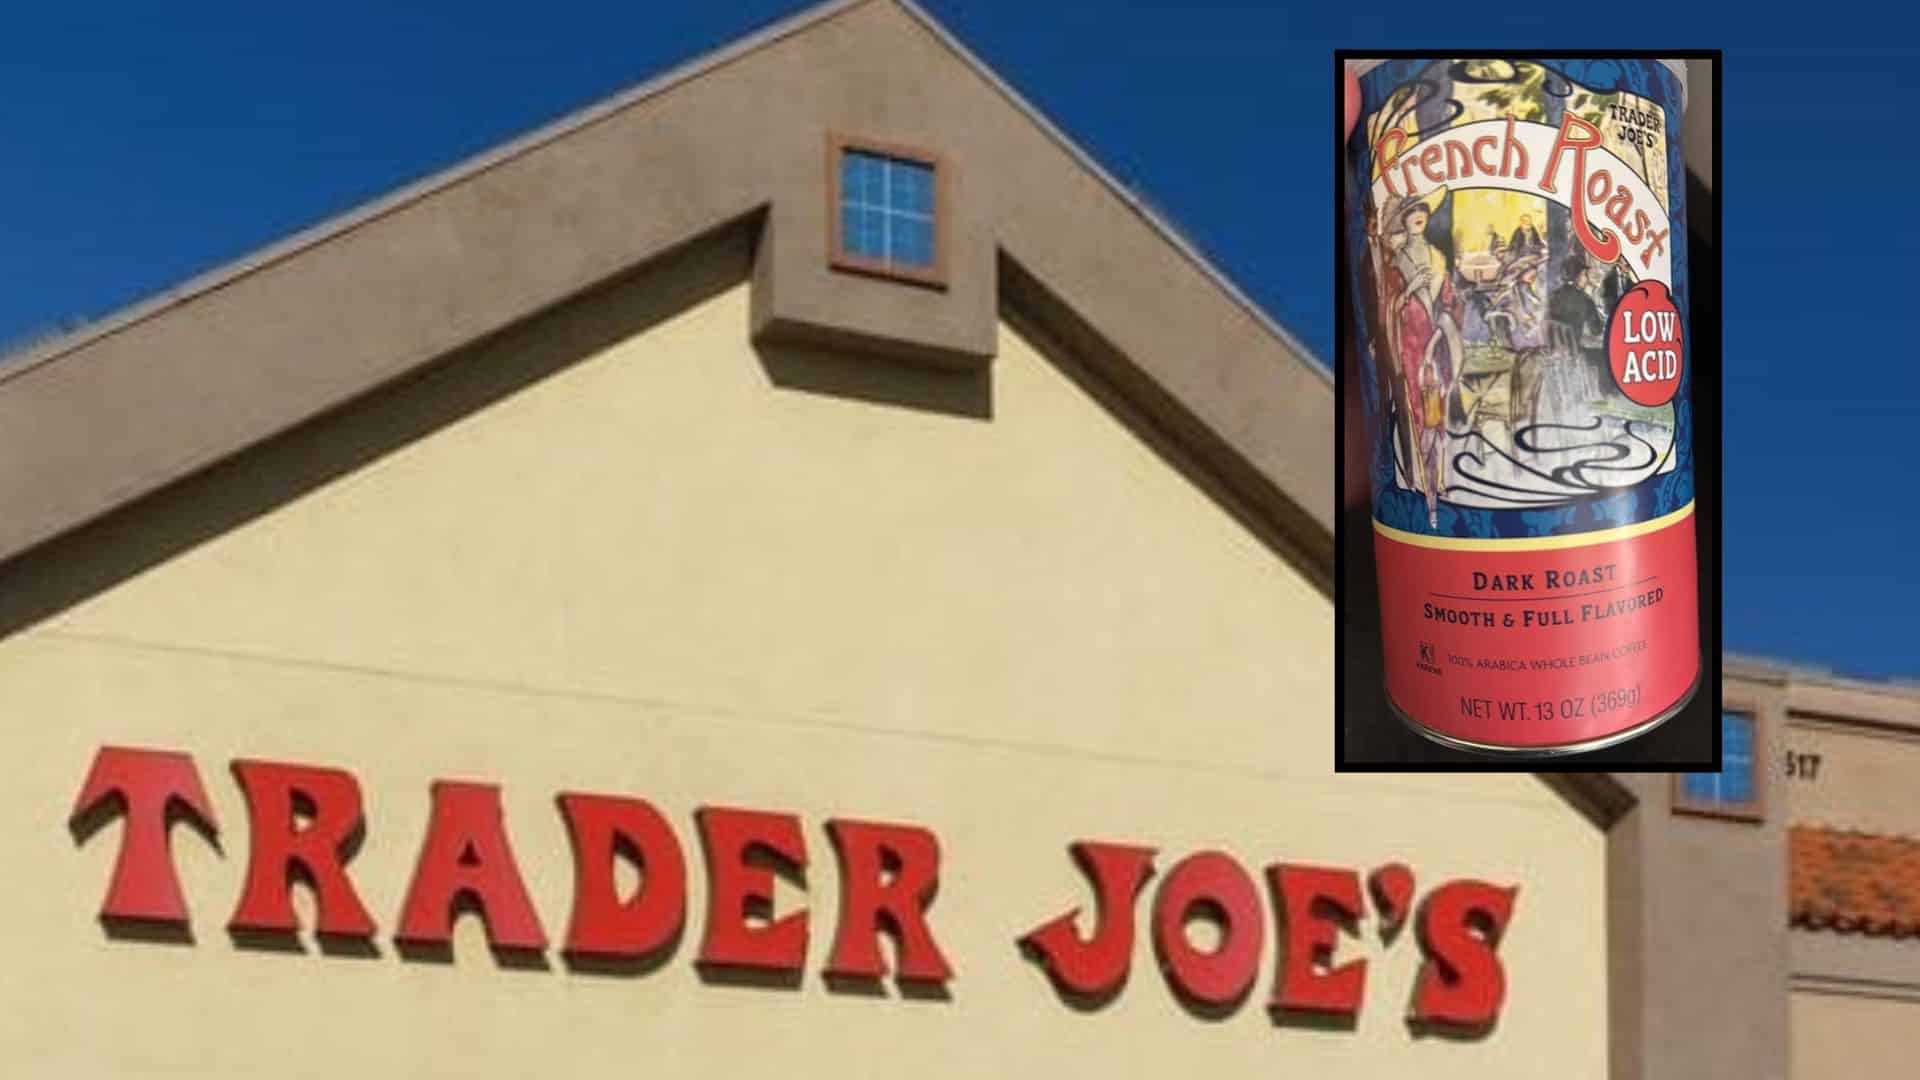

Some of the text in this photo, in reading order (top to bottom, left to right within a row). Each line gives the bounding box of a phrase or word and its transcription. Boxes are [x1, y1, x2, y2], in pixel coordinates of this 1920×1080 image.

[1610, 104, 1660, 131] TRADER
[1617, 126, 1654, 148] JOE'S
[1540, 111, 1669, 268] Roast
[1623, 311, 1675, 343] LOW
[1623, 350, 1677, 383] ACID
[1503, 614, 1515, 627] &
[1448, 639, 1649, 671] 100% ARABICA WHOLE BEAN COFFEE
[1459, 685, 1641, 721] NET WT. 13 OZ (369g)
[70, 746, 1520, 1040] TRADER JOE'S
